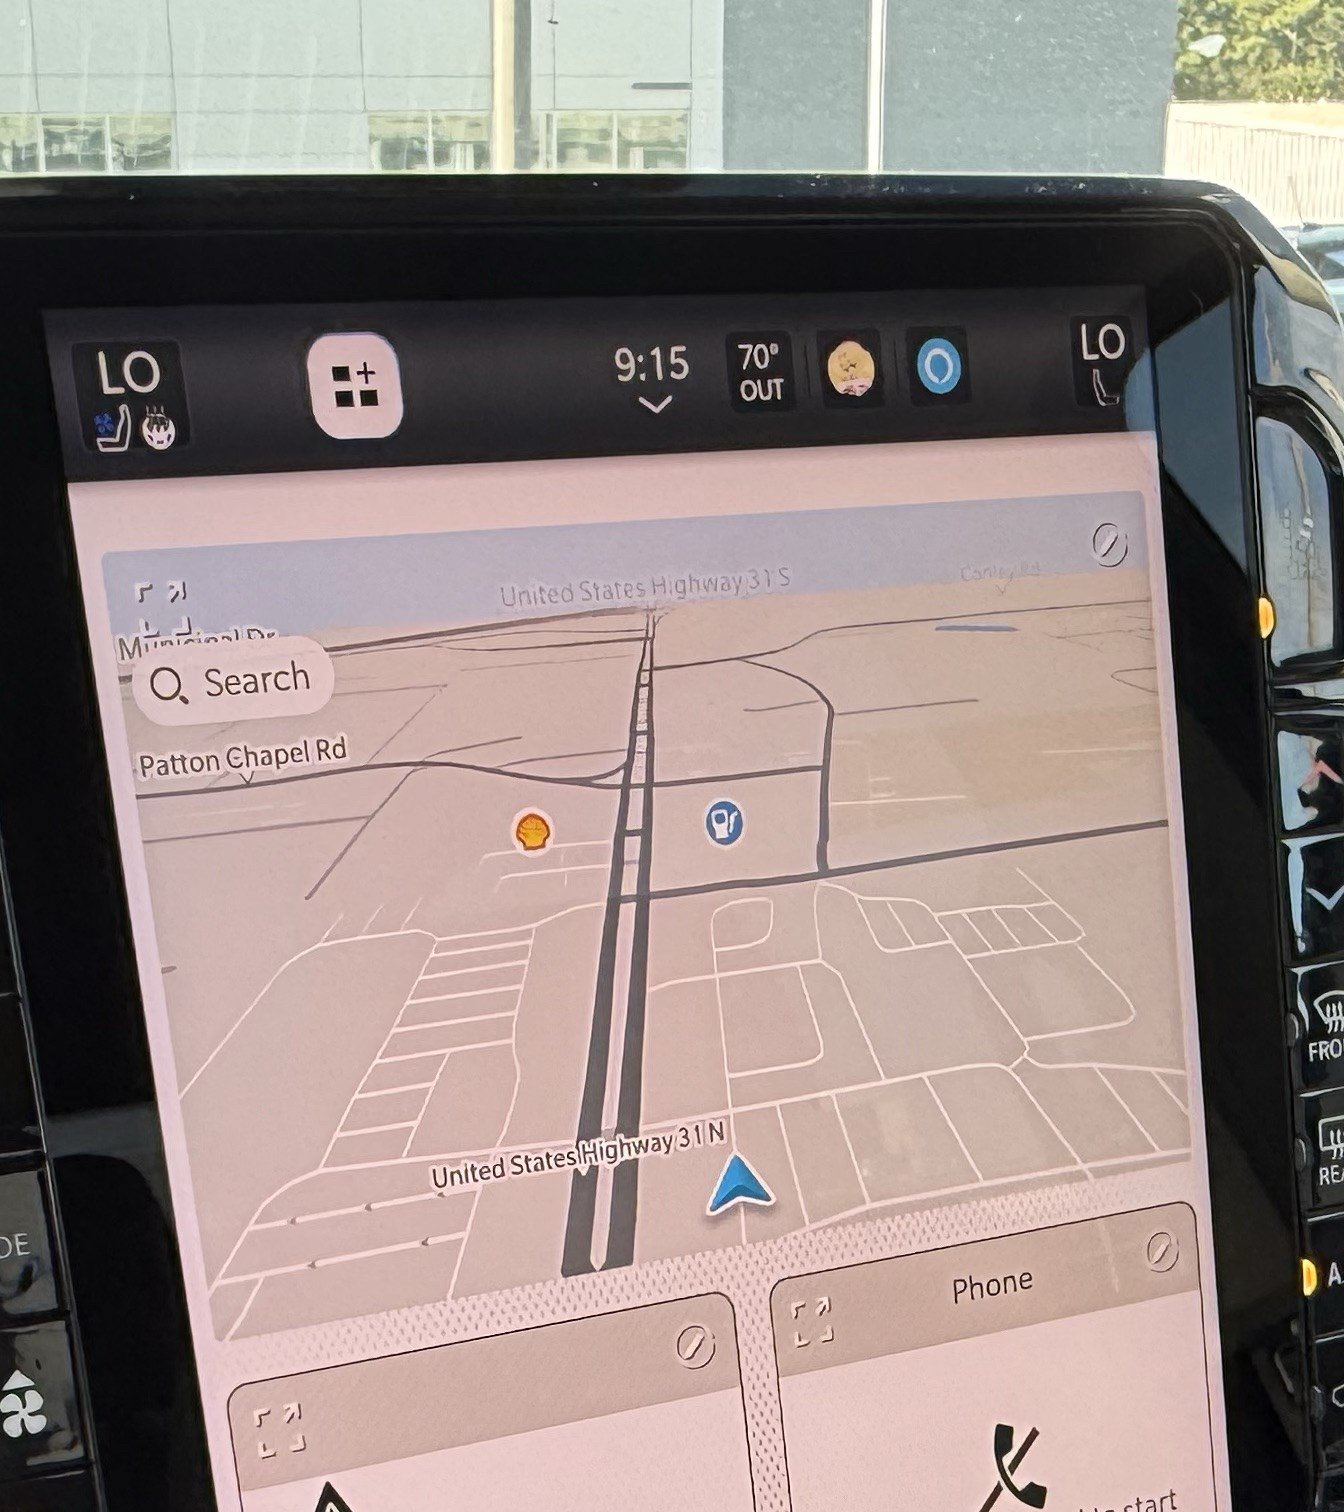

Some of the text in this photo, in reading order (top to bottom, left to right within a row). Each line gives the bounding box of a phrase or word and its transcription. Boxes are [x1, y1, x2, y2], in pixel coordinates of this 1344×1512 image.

[737, 342, 779, 371] 70°
[1080, 323, 1126, 361] LO
[97, 350, 160, 396] LO
[613, 345, 690, 383] 9:15
[739, 377, 786, 402] OUT
[500, 567, 791, 607] United States Highway 31 S
[204, 660, 311, 697] Search
[139, 735, 348, 778] Patton Chapel Rd
[431, 1120, 725, 1189] United States Highway 31 N
[951, 1268, 1034, 1306] Phone
